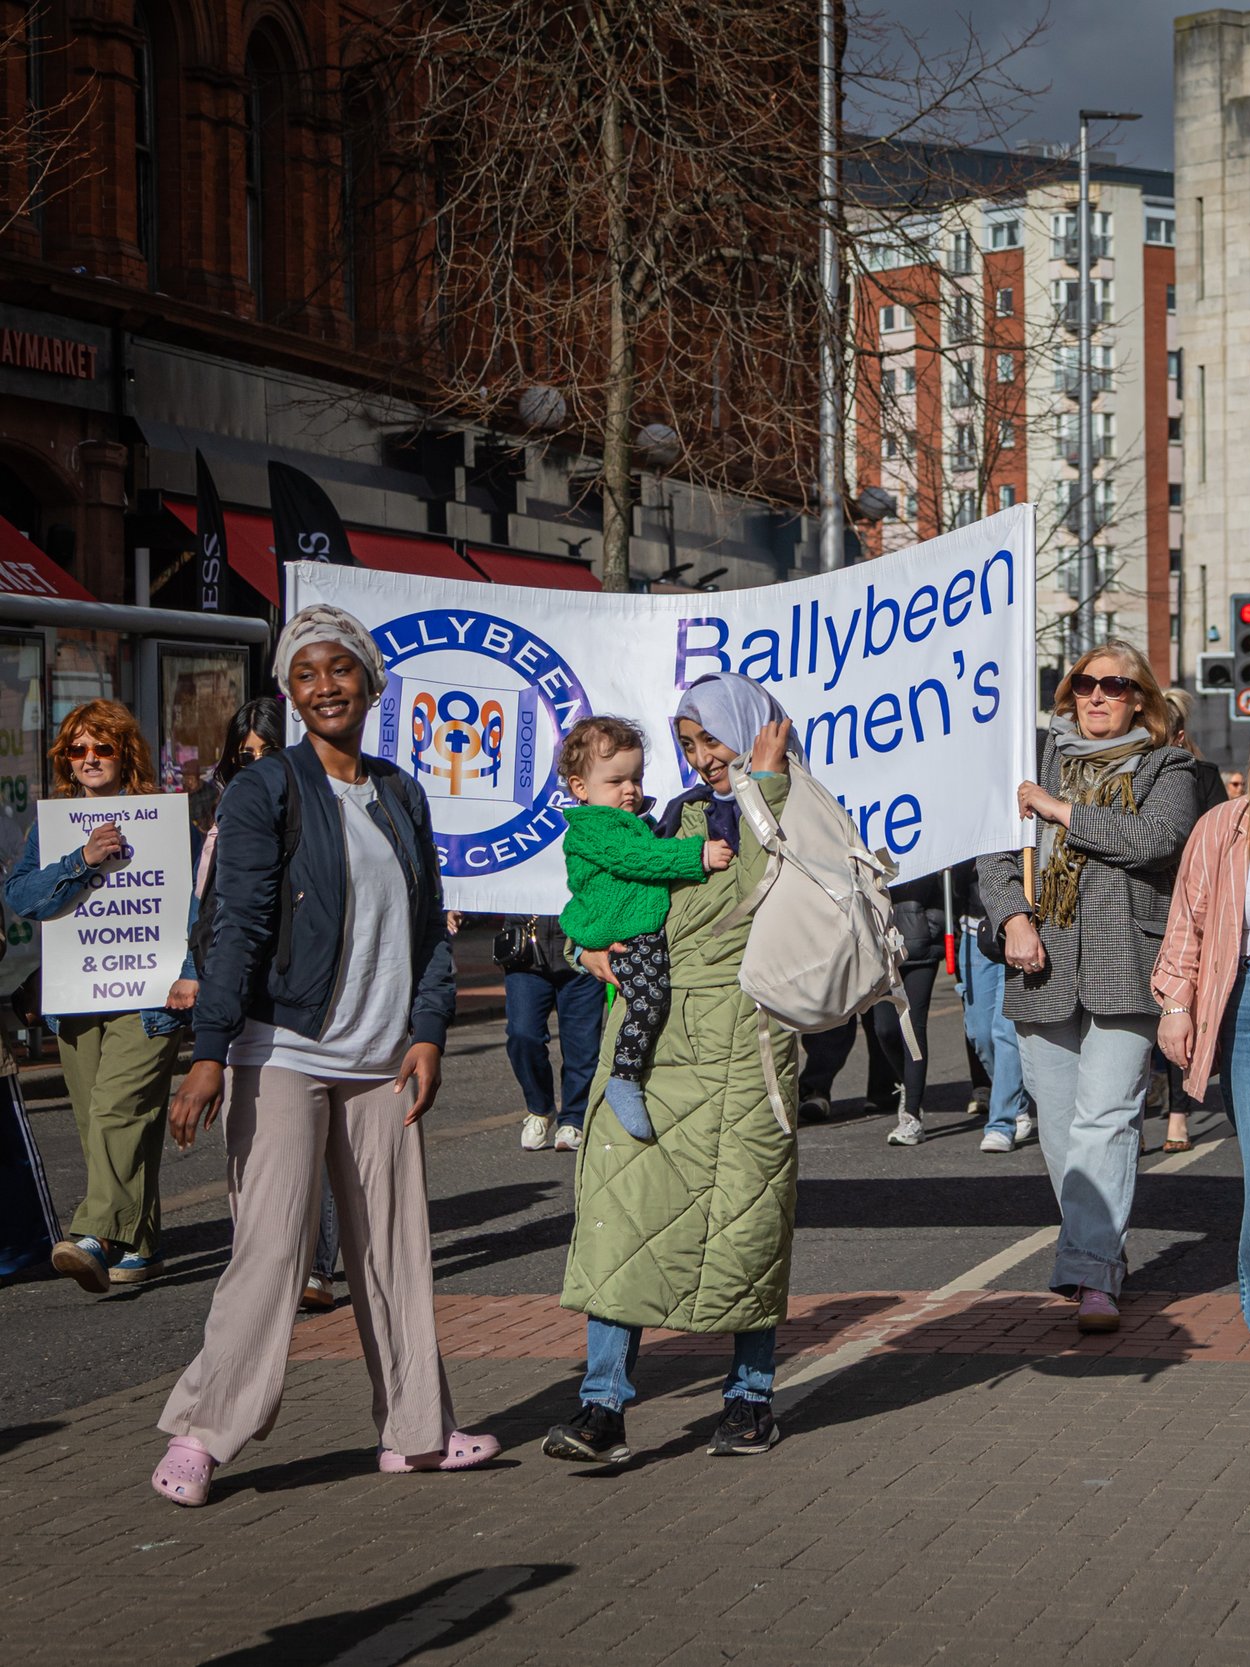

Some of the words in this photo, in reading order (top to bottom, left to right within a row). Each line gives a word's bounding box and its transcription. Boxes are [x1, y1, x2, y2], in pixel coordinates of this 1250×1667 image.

[1, 327, 98, 380] AYMARKET
[0, 560, 60, 594] KET
[674, 549, 1014, 691] Ballybeen
[384, 616, 582, 730] LLYBEEN
[382, 697, 396, 758] PENS
[518, 711, 534, 789] DOORS
[69, 810, 131, 831] Women's
[134, 808, 159, 820] Aid
[465, 776, 573, 868] CENTR
[74, 898, 162, 918] AGAINST
[77, 925, 160, 945] WOMEN
[82, 956, 98, 973] &
[101, 953, 157, 972] GIRLS
[92, 981, 146, 999] NOW
